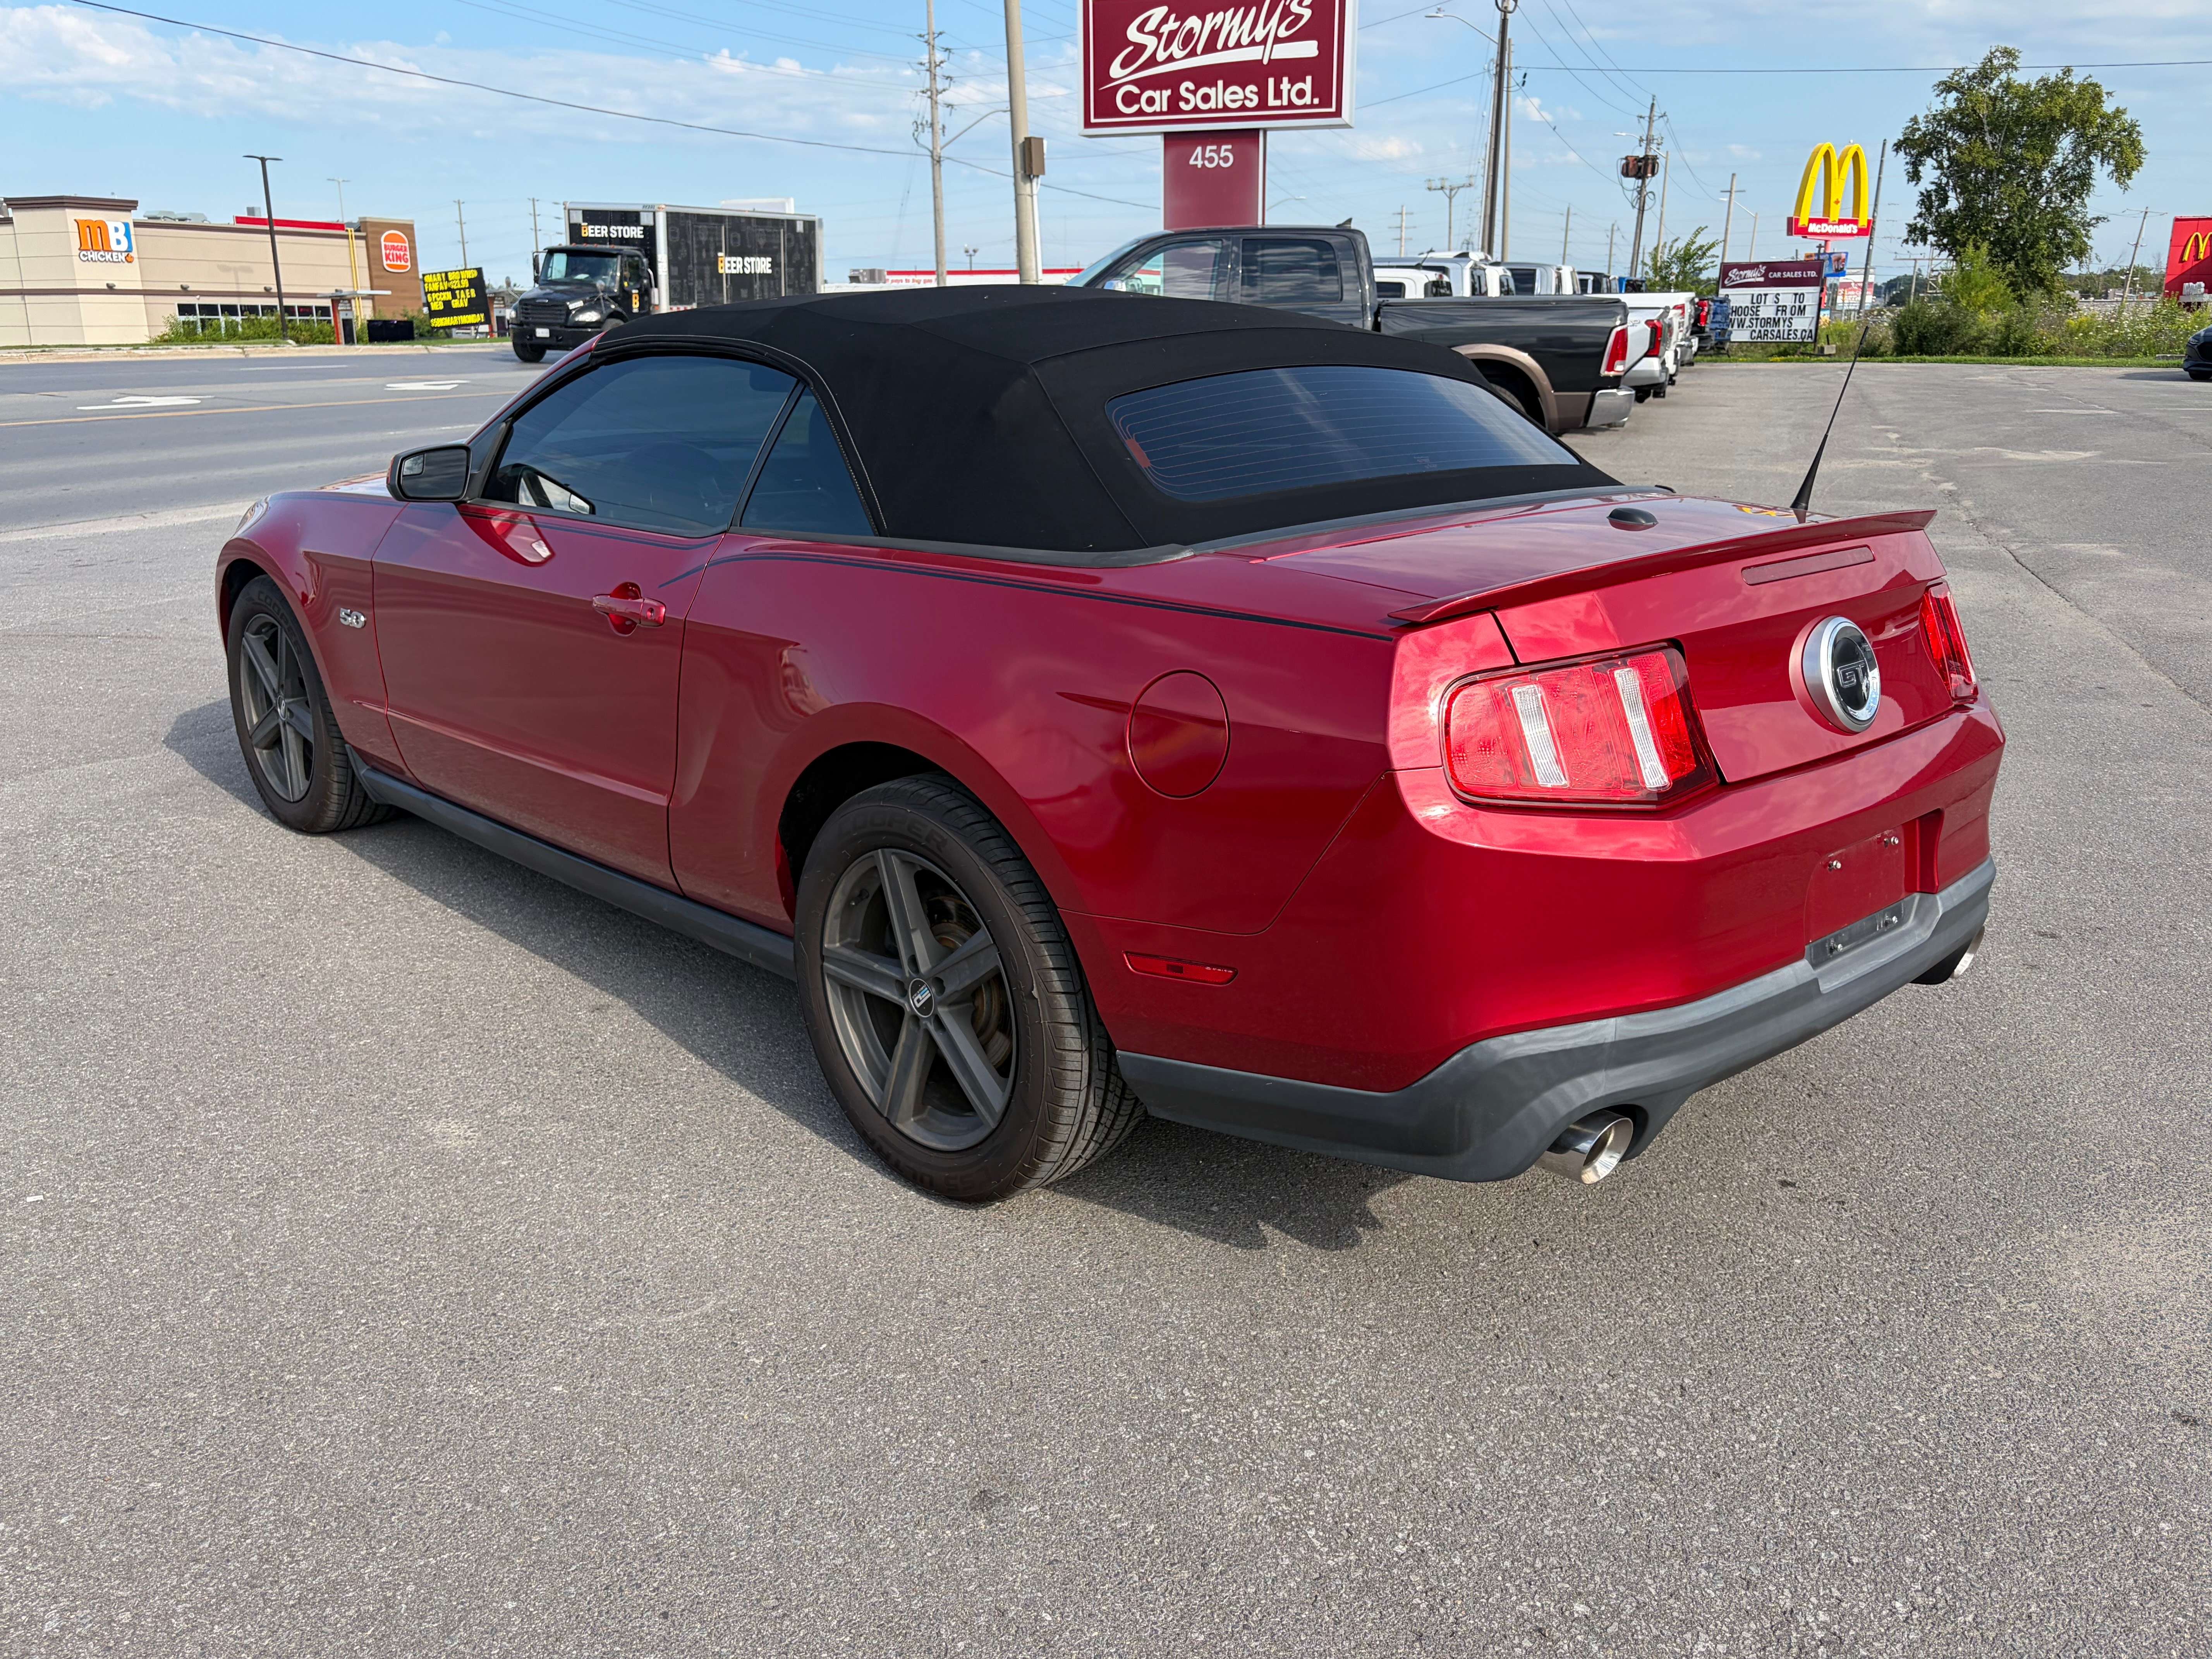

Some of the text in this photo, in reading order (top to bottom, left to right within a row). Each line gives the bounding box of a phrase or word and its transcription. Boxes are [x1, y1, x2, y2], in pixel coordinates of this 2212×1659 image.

[1109, 0, 1312, 78] Stormy's
[1116, 76, 1319, 113] Car Sales Ltd.
[1189, 144, 1233, 168] 455
[582, 223, 644, 238] BEER STORE
[1808, 223, 1858, 234] McDonald's
[79, 251, 125, 263] CHICKEN
[385, 252, 409, 263] KING
[718, 254, 772, 274] BEER STORE
[1793, 293, 1805, 304] TO
[1731, 306, 1761, 316] HOOSE
[1750, 329, 1813, 340] CARSALES.CA
[1837, 660, 1866, 689] GT
